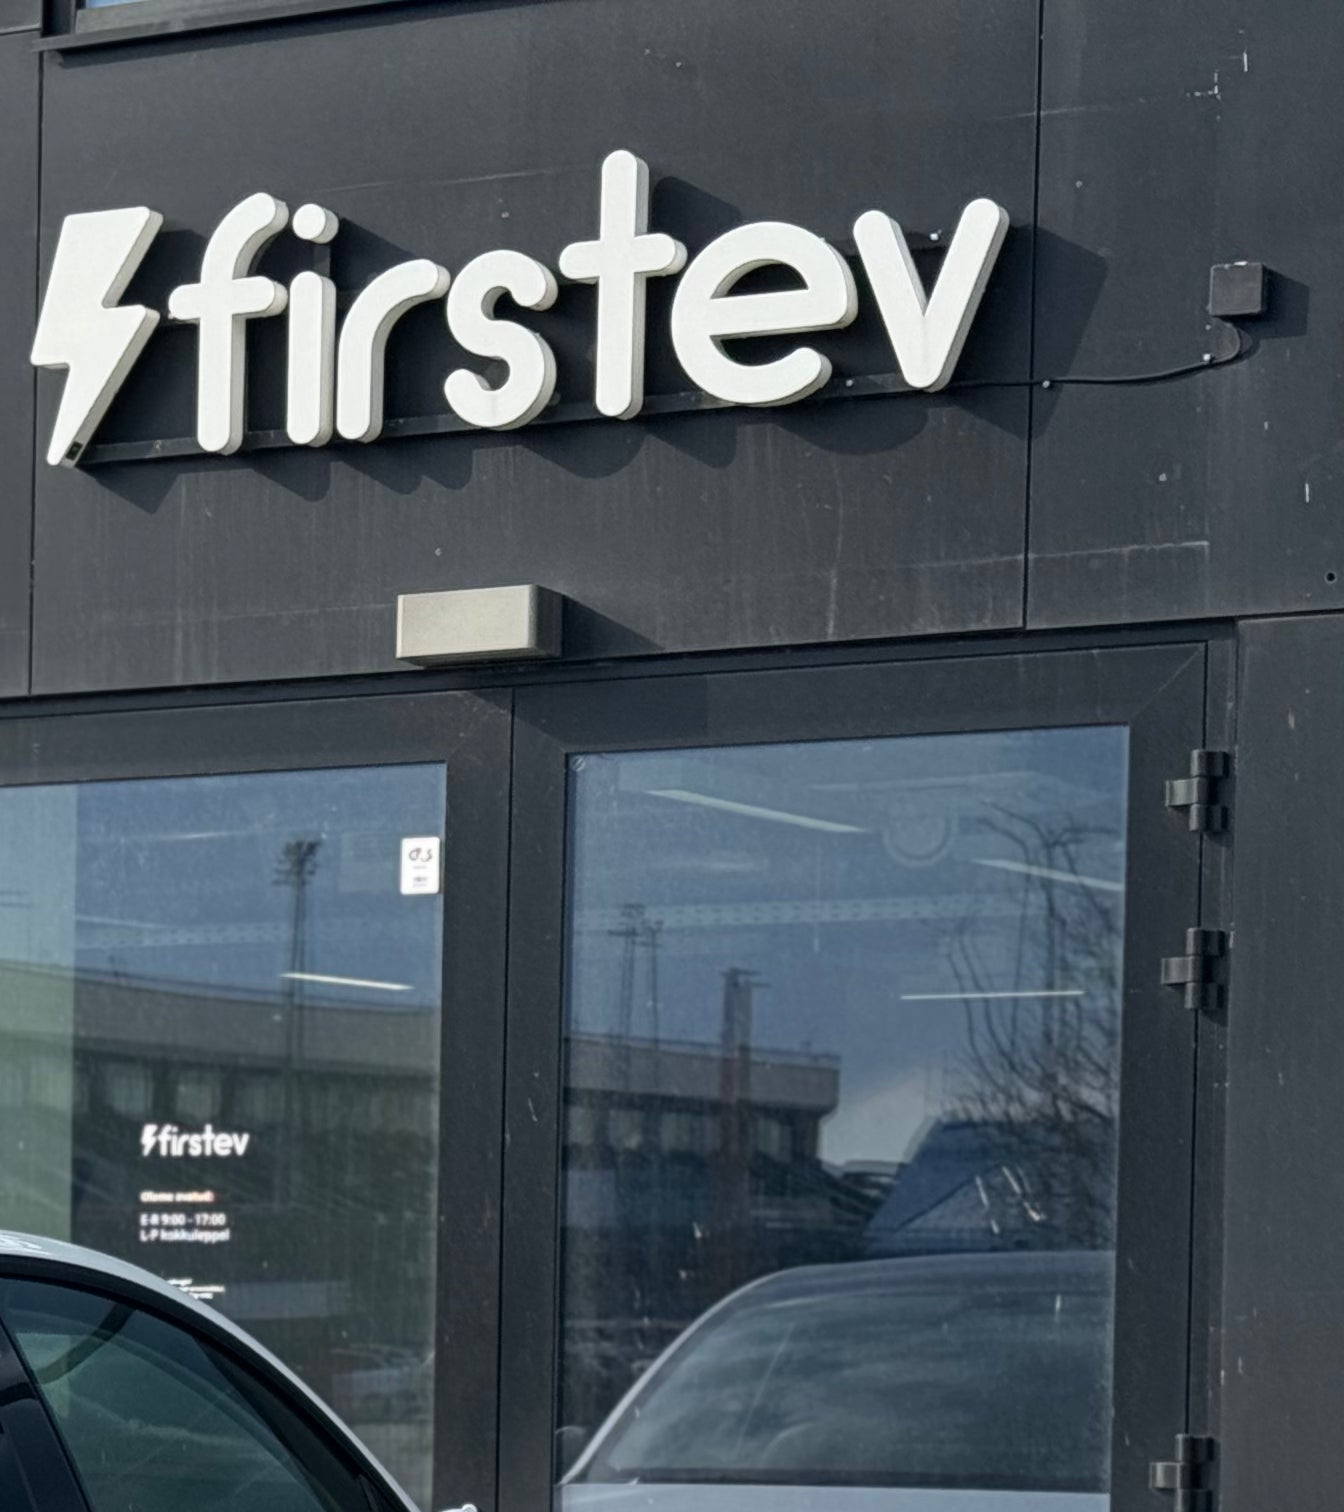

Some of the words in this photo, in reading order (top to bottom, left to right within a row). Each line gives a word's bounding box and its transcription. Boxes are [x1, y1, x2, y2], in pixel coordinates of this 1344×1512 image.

[169, 149, 1010, 455] firstev
[157, 1123, 250, 1157] firstev
[161, 1213, 186, 1226] 9:00
[195, 1213, 226, 1226] 17:00
[140, 1228, 158, 1242] L-P
[159, 1228, 230, 1244] kokkuleppel
